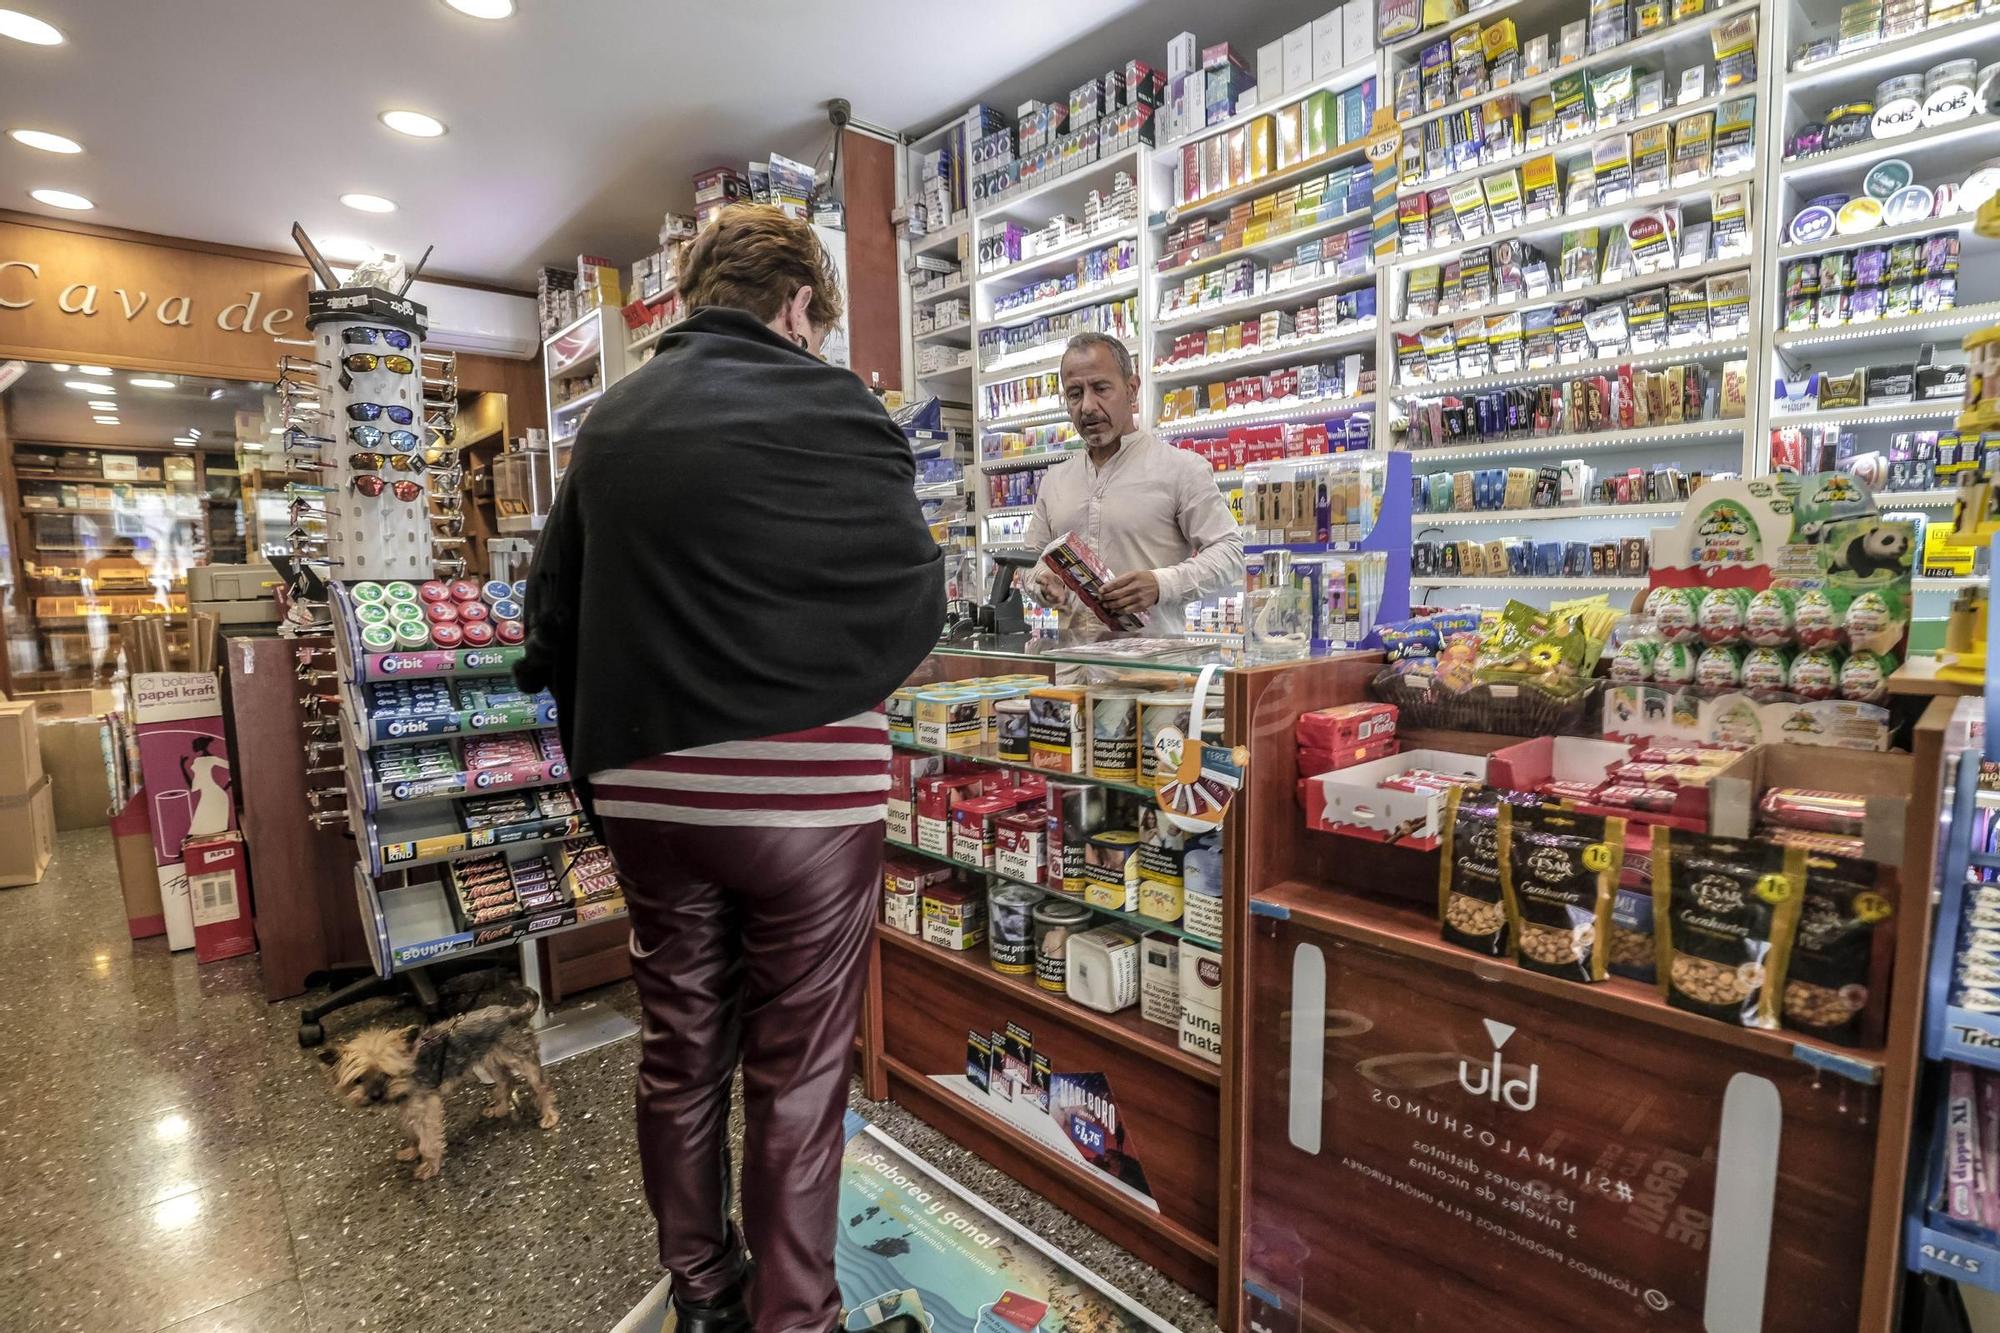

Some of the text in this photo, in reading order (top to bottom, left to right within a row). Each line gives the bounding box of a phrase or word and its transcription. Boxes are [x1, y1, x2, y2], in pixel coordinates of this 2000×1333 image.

[0, 260, 294, 336] Cava de
[1573, 381, 1583, 406] OCB
[1492, 546, 1502, 569] OCB
[1630, 541, 1640, 569] OCB
[382, 655, 424, 674] Orbit
[466, 652, 504, 667] Orbit
[138, 684, 216, 703] papel kraft
[388, 720, 429, 736] Orbit
[472, 713, 509, 728] Orbit
[918, 723, 940, 735] Fumar
[921, 735, 938, 745] mata
[477, 772, 513, 788] Orbit
[395, 783, 434, 799] Orbit
[887, 807, 911, 822] umar
[954, 850, 976, 864] mata
[1000, 849, 1029, 868] Fumar
[1526, 856, 1573, 874] CESAR
[1003, 866, 1026, 879] mata
[927, 920, 955, 937] Fumar
[931, 933, 952, 948] mata
[402, 939, 456, 961] BOUNTY
[1180, 1005, 1221, 1035] Fuma
[1059, 1078, 1116, 1136] MARLBORO
[1951, 1102, 1967, 1180] dipper XL
[857, 1153, 933, 1204] ¡Saborea
[924, 1201, 945, 1215] y
[937, 1210, 1000, 1249] gana!
[1920, 1244, 1980, 1273] ALLS
